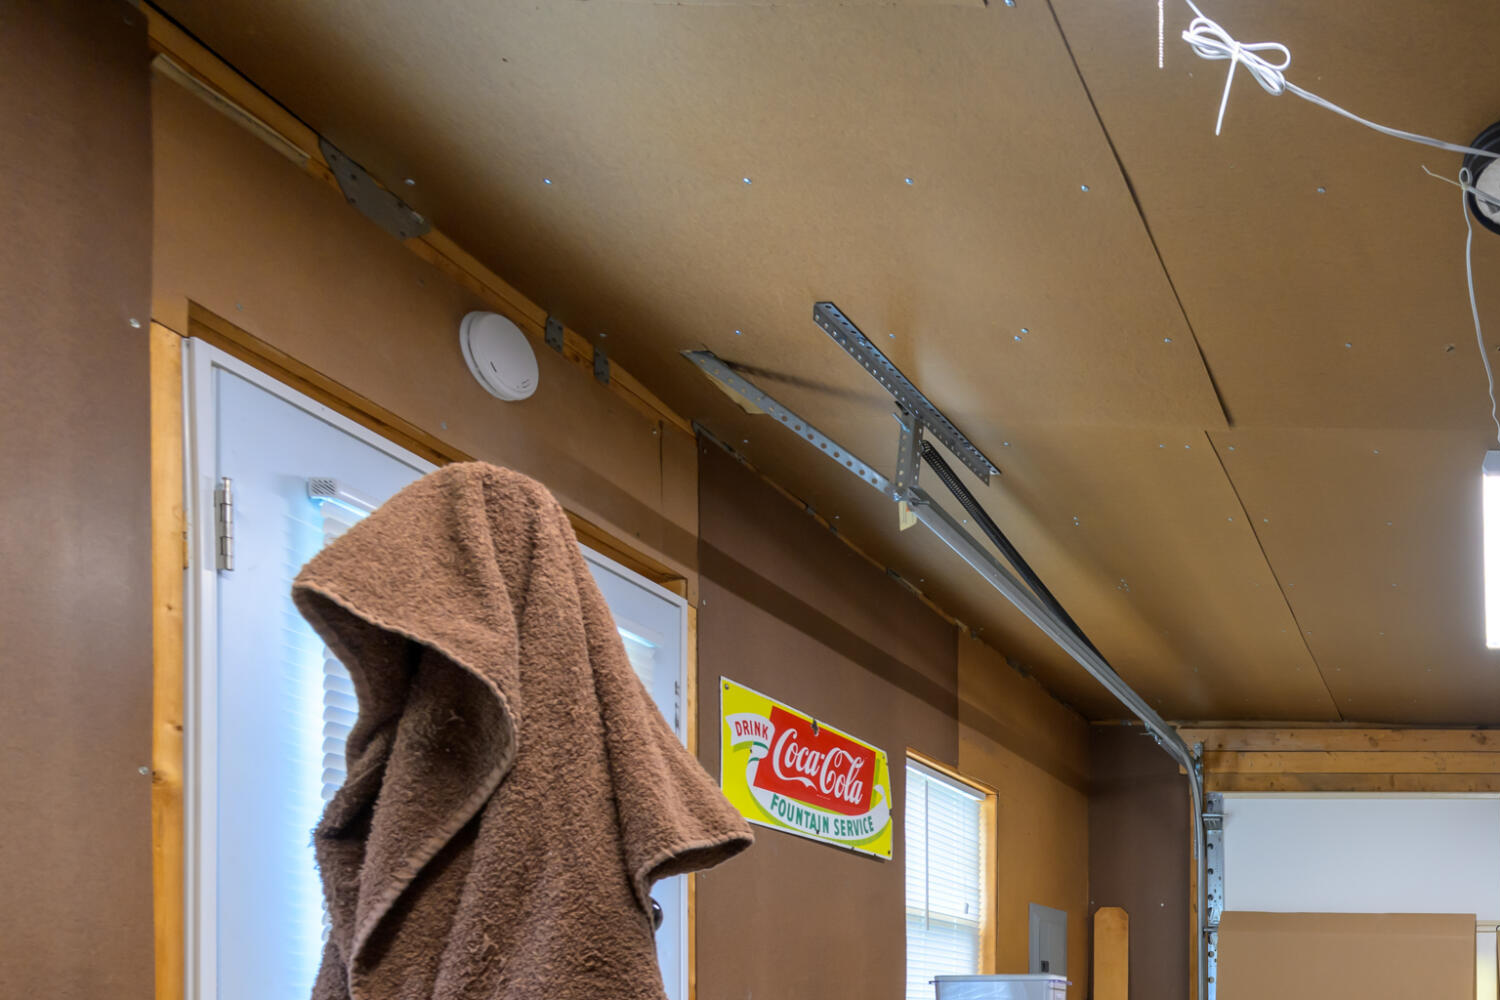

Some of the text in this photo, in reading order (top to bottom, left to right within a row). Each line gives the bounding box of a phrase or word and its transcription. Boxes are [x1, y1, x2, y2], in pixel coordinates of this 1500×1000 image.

[734, 719, 769, 741] DRINK
[770, 793, 875, 837] FOUNTAIN SERVICE
